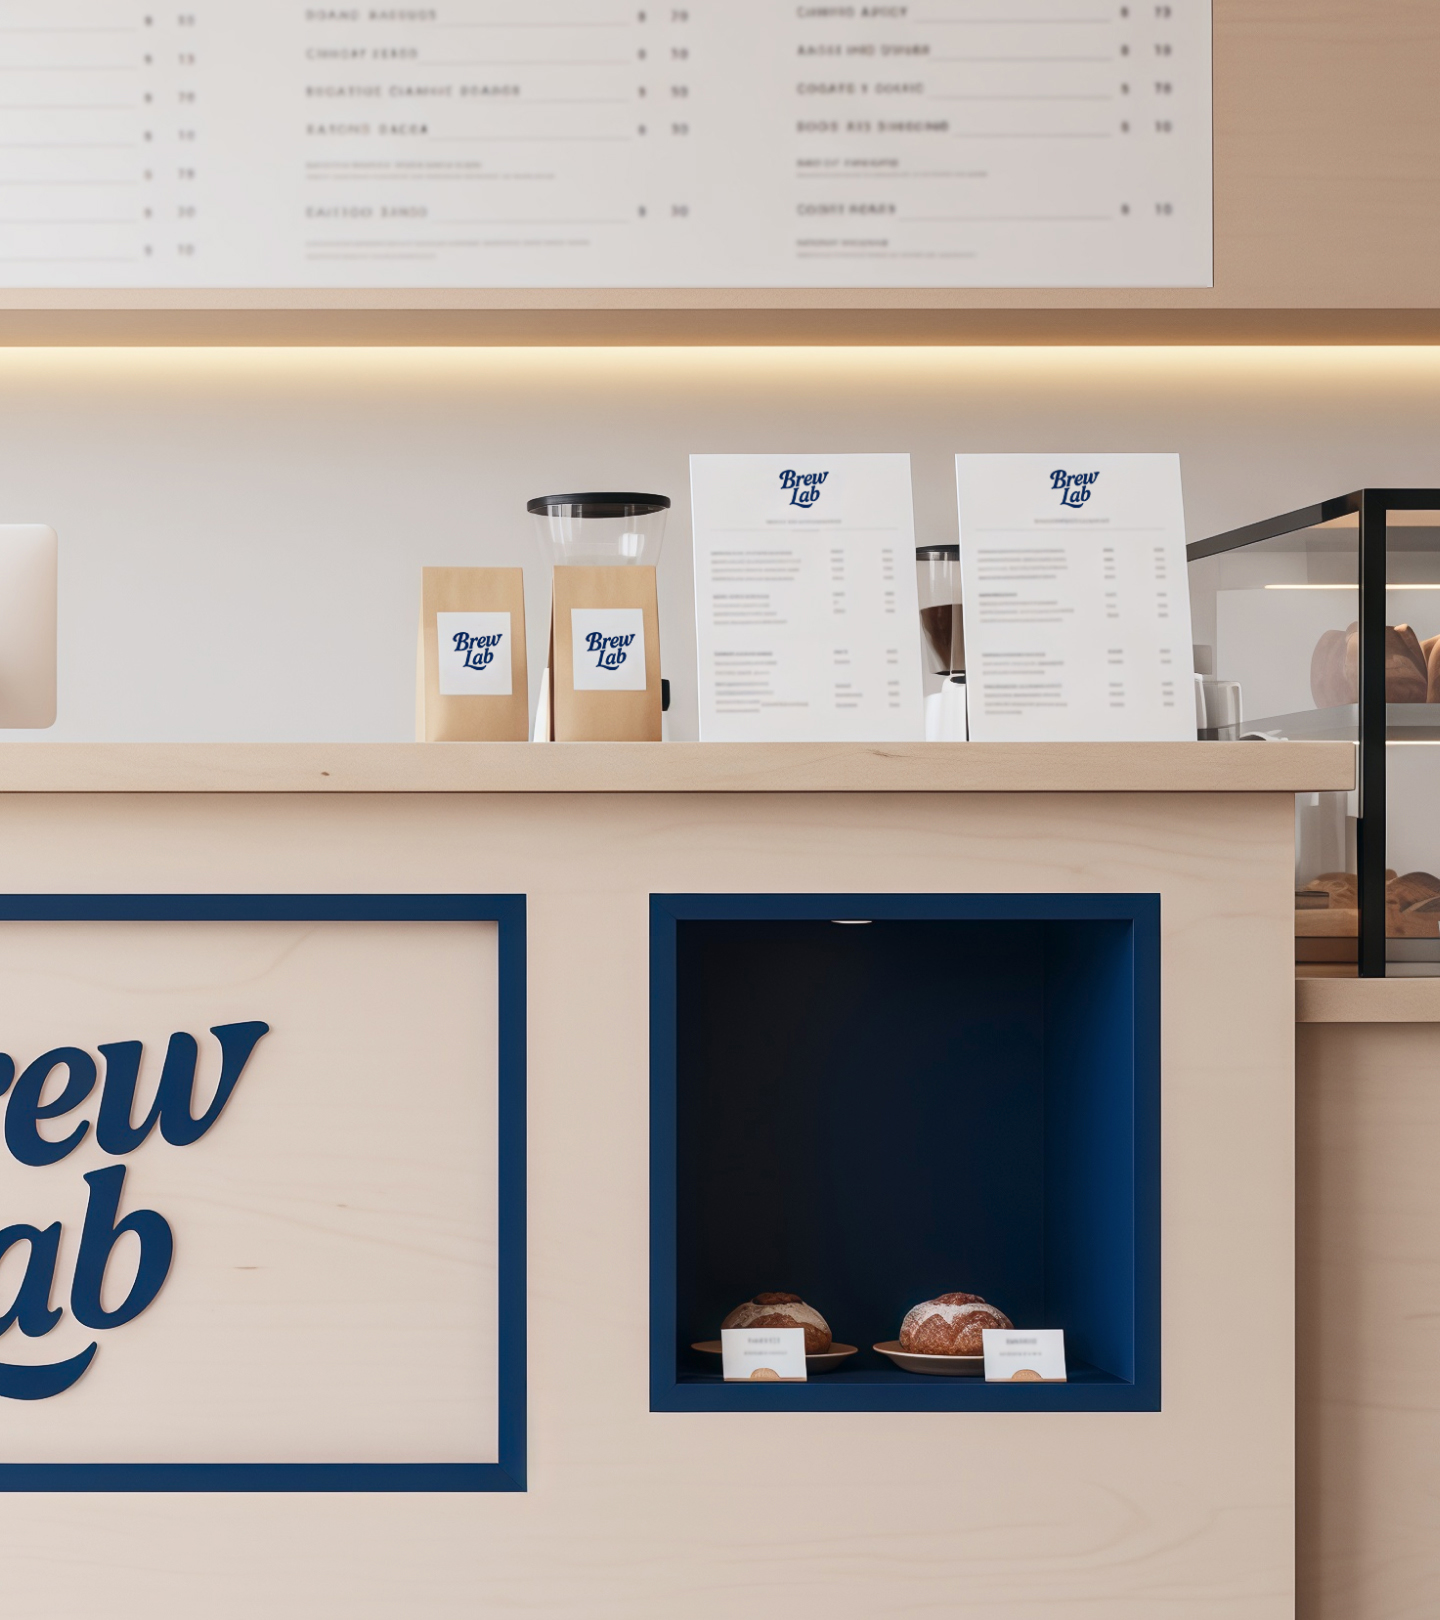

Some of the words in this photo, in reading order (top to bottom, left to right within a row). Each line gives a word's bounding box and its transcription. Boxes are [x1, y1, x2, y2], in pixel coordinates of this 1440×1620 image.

[779, 470, 828, 489] Brew
[1050, 470, 1099, 489] Brew
[789, 485, 820, 508] Lab
[1060, 485, 1091, 508] Lab
[453, 632, 502, 651] Brew
[586, 632, 635, 651] Brew
[463, 647, 494, 670] Lab
[596, 647, 627, 670] Lab
